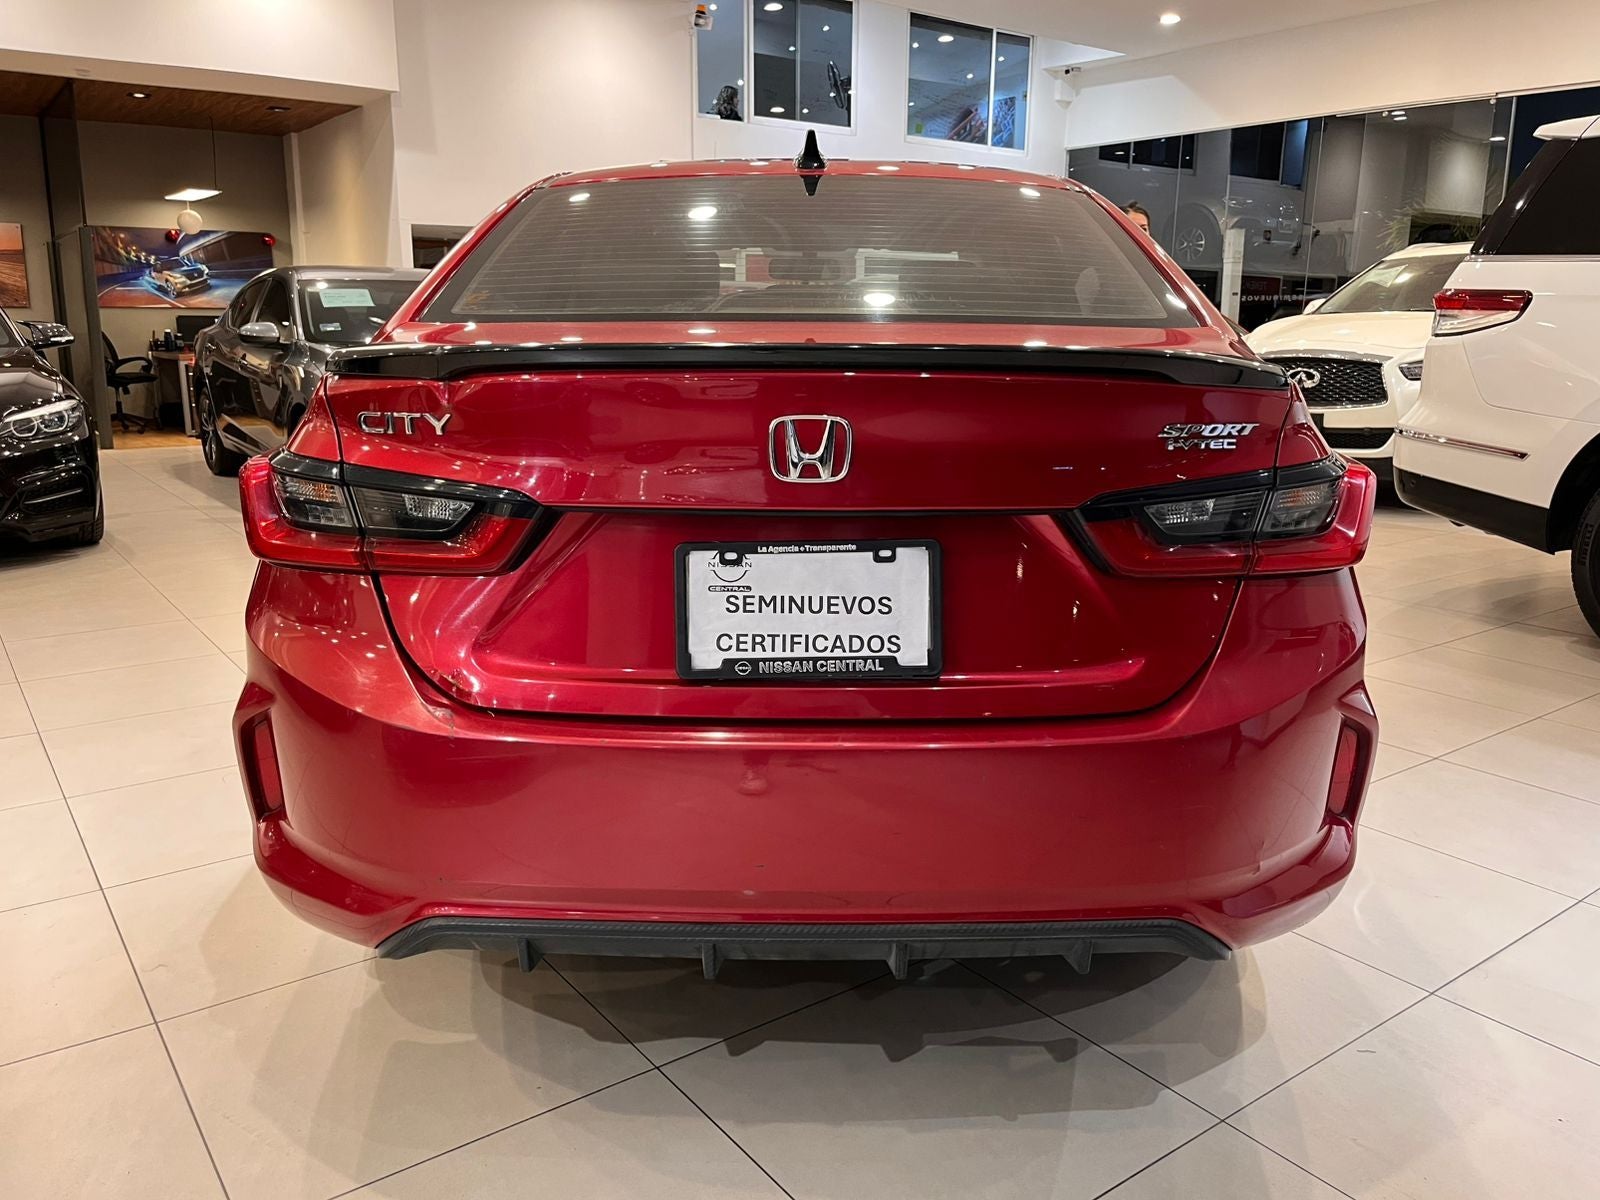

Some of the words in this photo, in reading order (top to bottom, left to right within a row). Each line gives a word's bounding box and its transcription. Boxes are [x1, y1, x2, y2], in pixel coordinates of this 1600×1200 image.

[357, 411, 451, 435] CITY
[1158, 423, 1260, 437] SPORT
[757, 545, 767, 553] La
[768, 544, 799, 554] Agencia
[725, 594, 893, 615] SEMINUEVOS
[716, 633, 902, 653] CERTIFICADOS
[758, 660, 814, 674] NISSAN
[816, 659, 884, 673] CENTRAL
